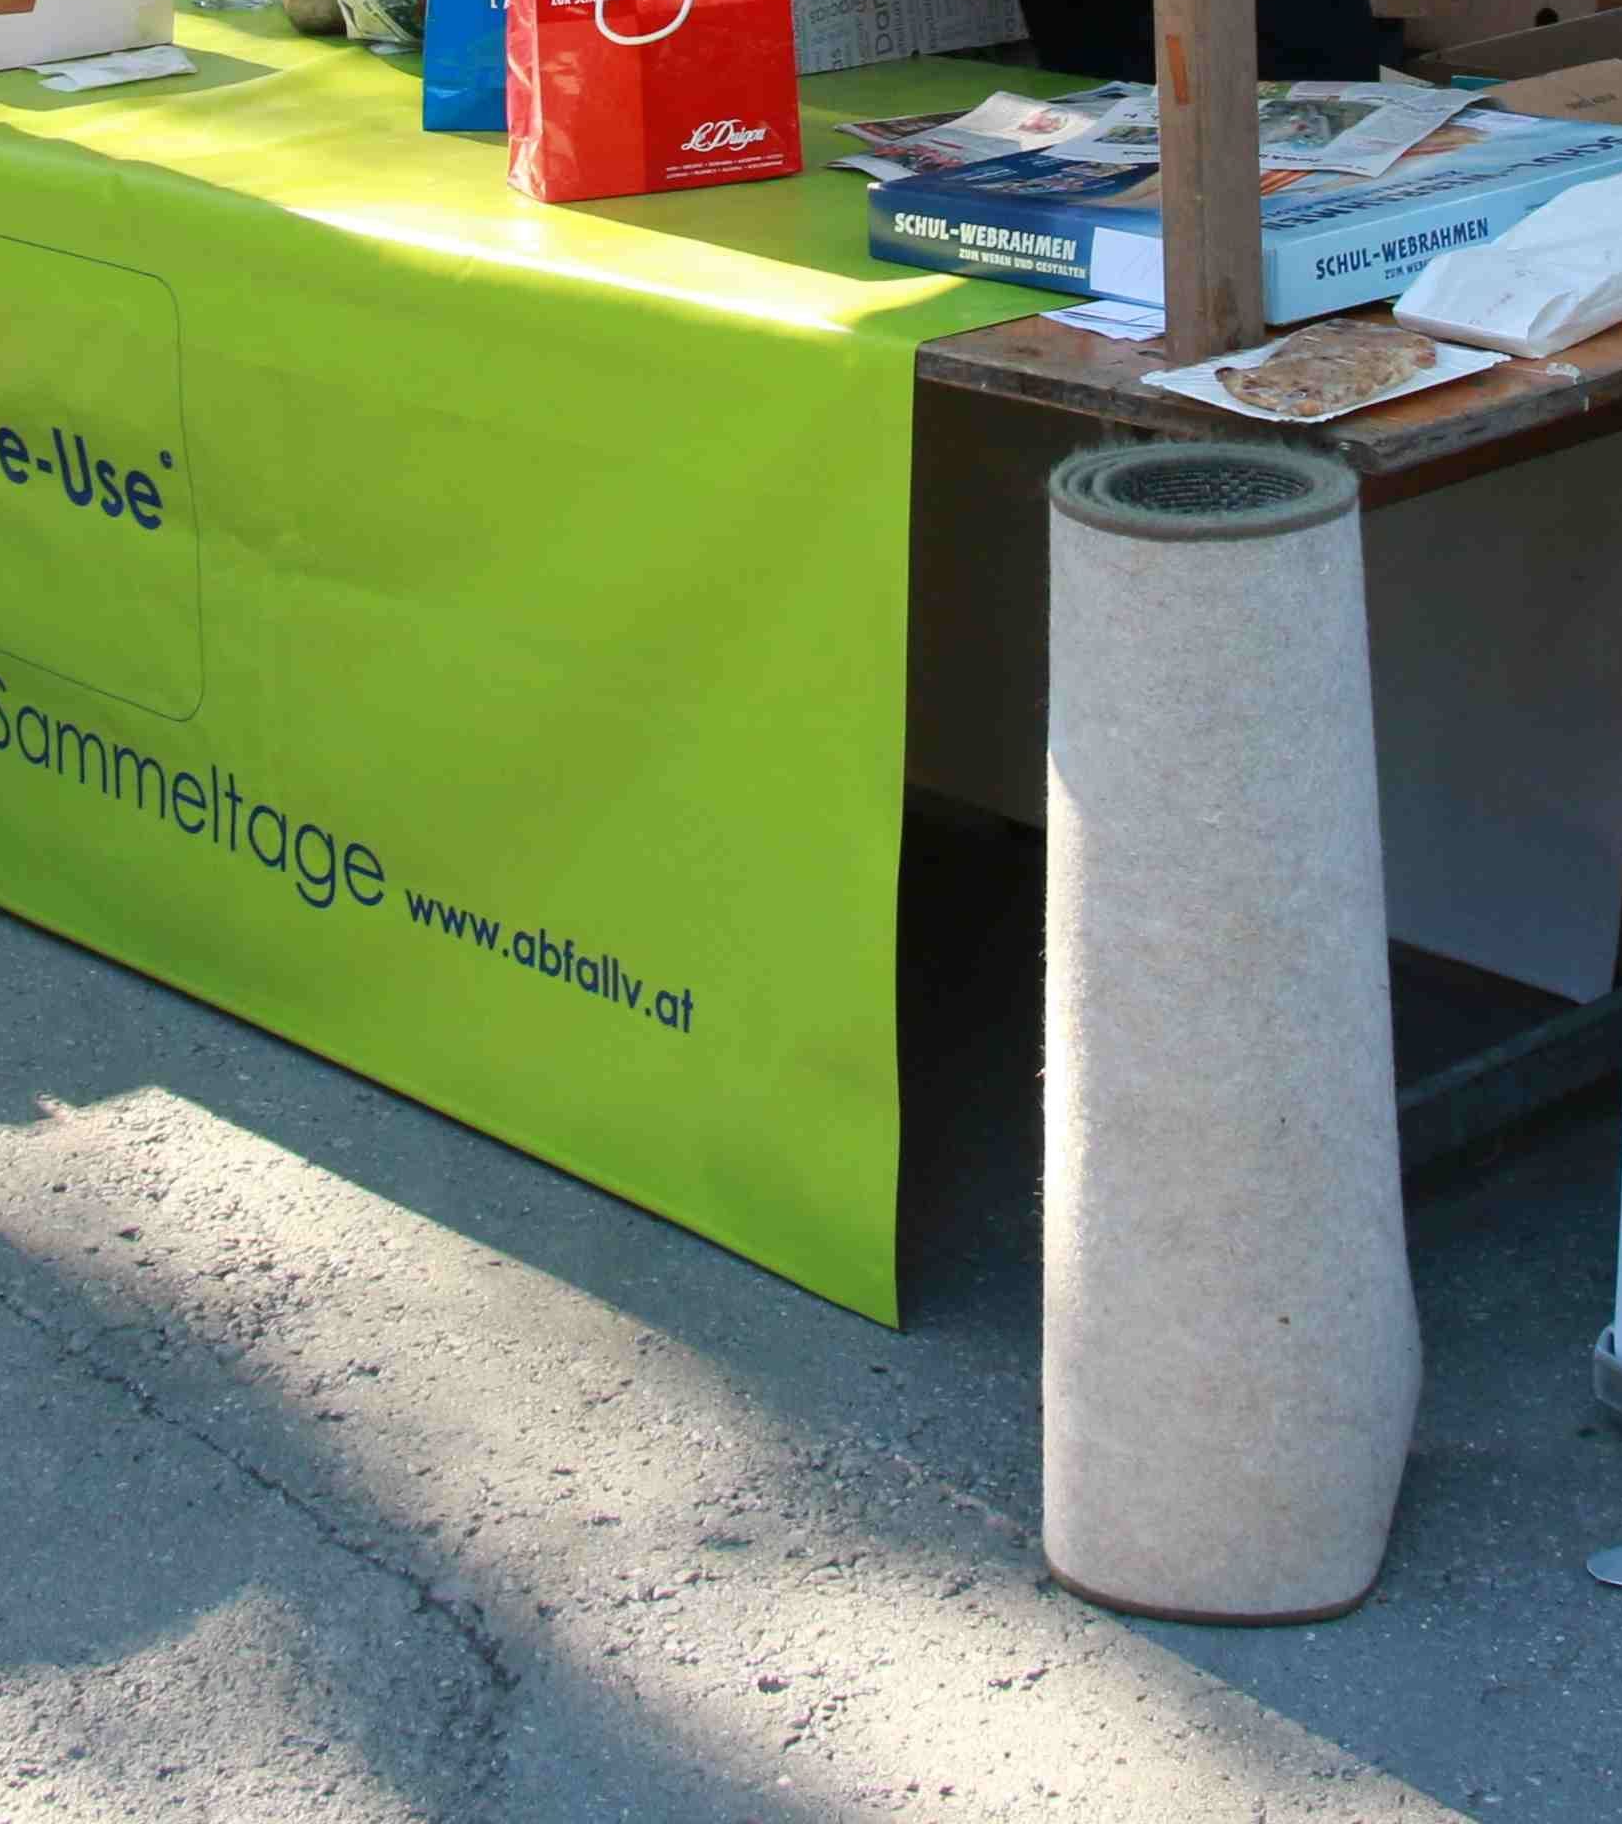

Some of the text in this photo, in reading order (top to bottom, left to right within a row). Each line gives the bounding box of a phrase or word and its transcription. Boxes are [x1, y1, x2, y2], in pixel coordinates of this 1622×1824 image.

[894, 213, 1077, 261] SCHUL-WEBRAHMEN
[1315, 217, 1488, 280] SCHUL-WEBRAHMEN
[405, 885, 694, 1034] www.abfallv.at
